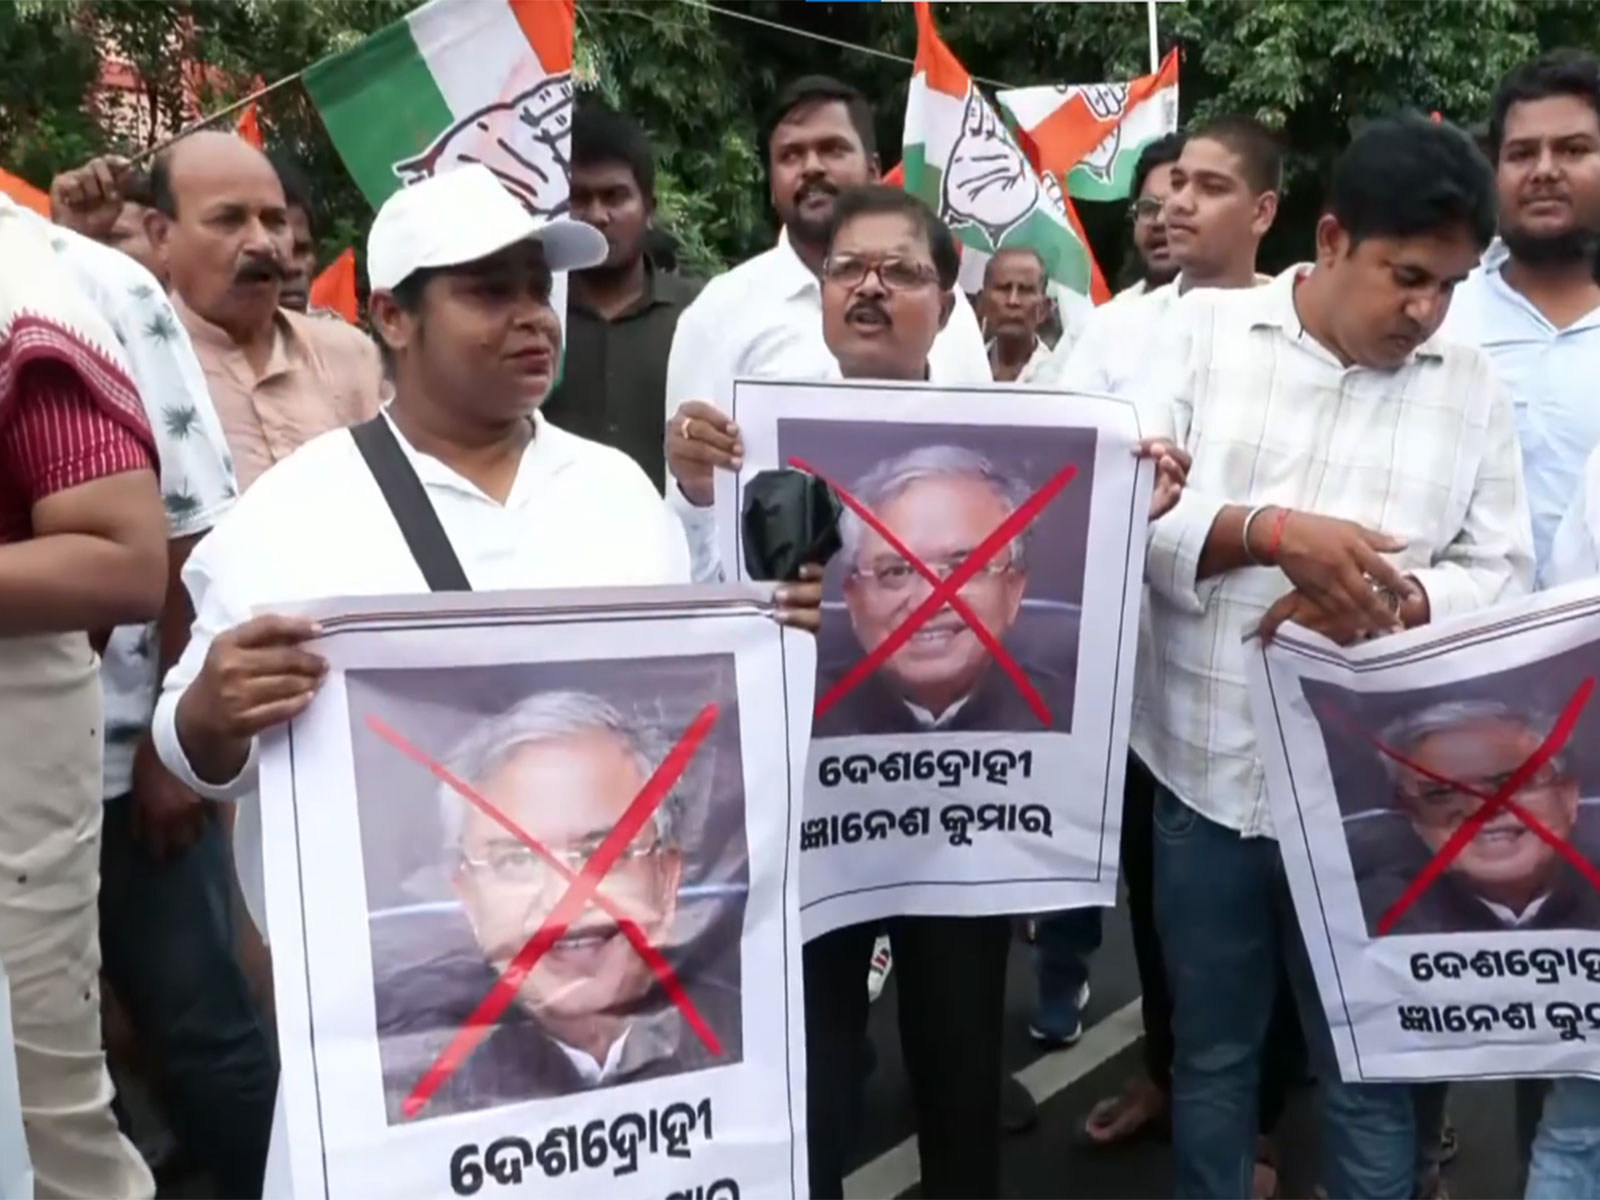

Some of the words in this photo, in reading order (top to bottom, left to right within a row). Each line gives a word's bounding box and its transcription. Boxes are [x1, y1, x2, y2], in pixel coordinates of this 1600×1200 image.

[818, 749, 1032, 788] ଦେଶଦ୍ରୋହୀ
[939, 803, 1052, 847] କୁମାର
[1397, 1001, 1537, 1033] ଜ୍ଞାନେଶ
[449, 1097, 713, 1196] ଦେଶଦ୍ରୋହୀ
